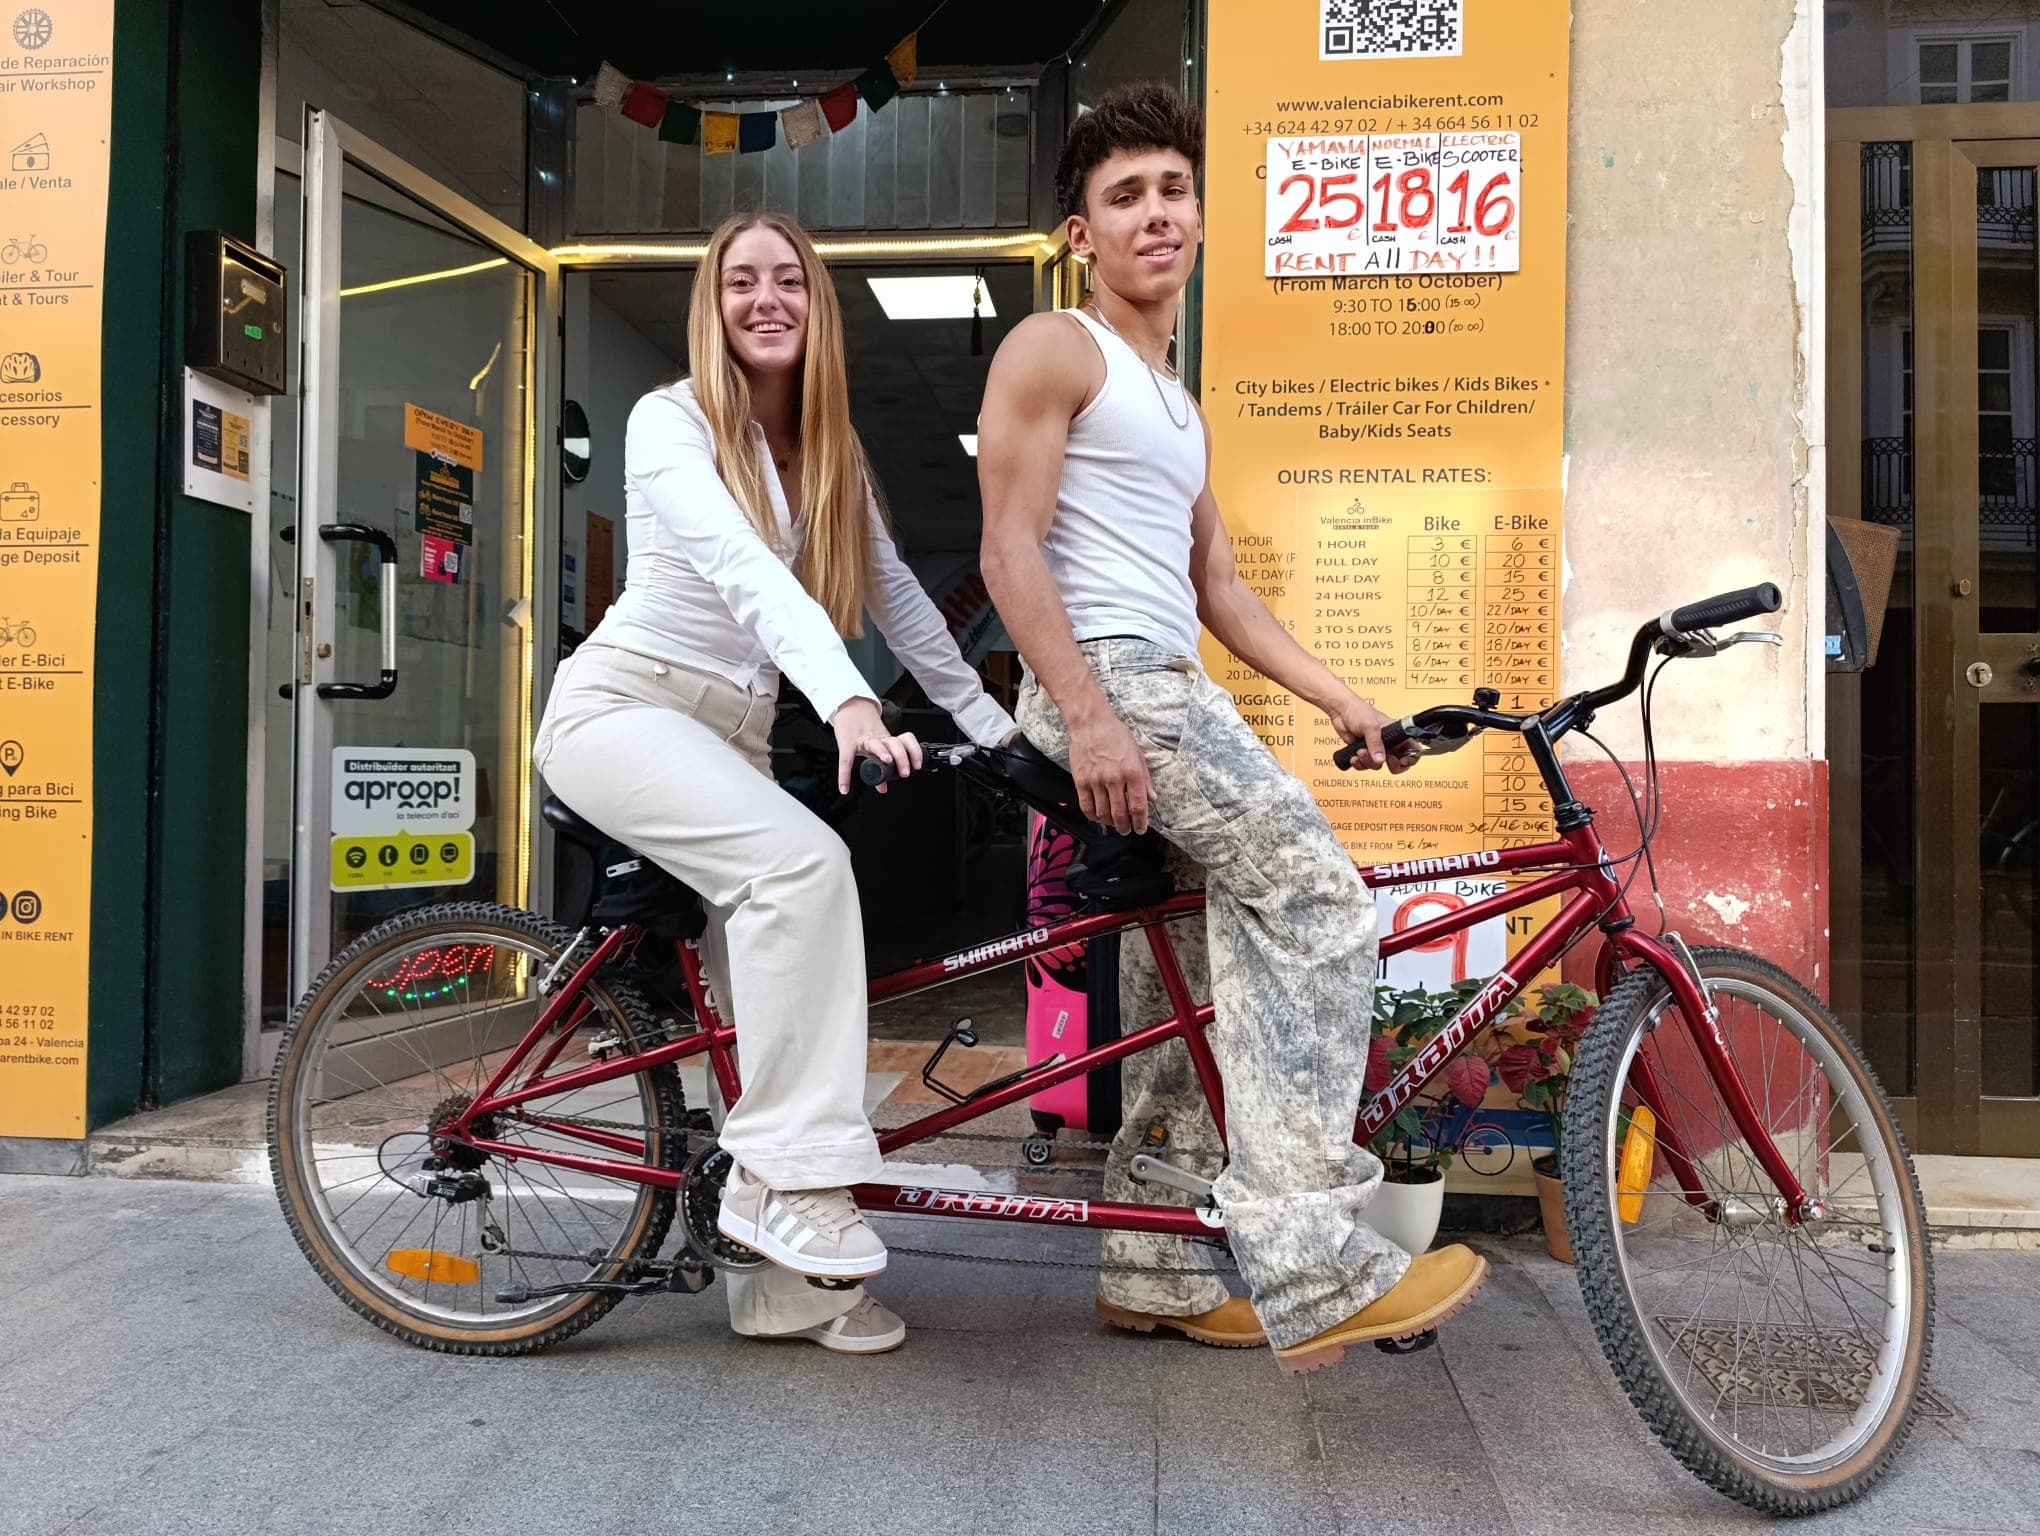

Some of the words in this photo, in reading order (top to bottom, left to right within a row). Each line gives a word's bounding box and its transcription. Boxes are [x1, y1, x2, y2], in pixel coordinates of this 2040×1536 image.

[1, 57, 19, 69] de
[24, 54, 109, 71] Reparación
[21, 78, 96, 92] Workshop
[1277, 95, 1503, 112] www.valenciabikerent.com
[1242, 121, 1272, 135] +34
[1277, 120, 1305, 134] 624
[1310, 120, 1329, 133] 42
[1334, 119, 1353, 133] 97
[1358, 119, 1377, 132] 02
[1412, 117, 1432, 130] 34
[1436, 116, 1465, 130] 664
[1471, 115, 1490, 129] 56
[1497, 115, 1512, 128] 11
[1519, 114, 1539, 128] 02
[1442, 134, 1516, 147] ELECTRIC
[1278, 139, 1365, 158] YAMAHA
[1442, 149, 1518, 168] SCOOTER
[30, 176, 72, 189] Venta
[1278, 173, 1364, 233] 25
[1373, 168, 1434, 232] 18
[1447, 169, 1515, 236] 16
[1269, 235, 1292, 246] CASH
[1372, 235, 1396, 243] CASH
[1440, 236, 1466, 245] CASH
[1276, 252, 1356, 273] RENT
[1407, 250, 1468, 272] DAY
[30, 270, 41, 283] &
[45, 269, 79, 282] Tour
[1273, 277, 1326, 292] (From
[1332, 275, 1389, 290] March
[1395, 276, 1413, 289] to
[1418, 273, 1503, 291] October)
[27, 292, 69, 305] Tours
[1333, 299, 1367, 313] 9:30
[1370, 299, 1392, 312] TO
[1330, 322, 1371, 336] 18:00
[1375, 321, 1397, 335] TO
[1235, 380, 1267, 398] City
[1272, 379, 1315, 394] bikes
[1330, 378, 1391, 393] Electric
[1395, 377, 1439, 392] bikes
[1454, 377, 1490, 392] Kids
[1495, 376, 1538, 391] Bikes
[1248, 402, 1322, 417] Tandems
[1336, 400, 1388, 416] Tráiler
[1393, 400, 1421, 415] Car
[1425, 400, 1452, 414] For
[1319, 423, 1402, 442] Baby/Kids
[1407, 424, 1452, 437] Seats
[1278, 469, 1333, 484] OURS
[1340, 468, 1416, 484] RENTAL
[1423, 468, 1491, 483] RATES:
[1320, 516, 1361, 525] Valencia
[1424, 516, 1461, 531] Bike
[1494, 515, 1549, 530] E-Bike
[16, 527, 81, 543] Equipaje
[1238, 536, 1273, 547] HOUR
[1327, 540, 1367, 549] HOUR
[1430, 536, 1445, 552] 3
[1511, 537, 1523, 551] 6
[23, 550, 81, 565] Deposit
[1259, 553, 1283, 564] DAY
[1316, 558, 1347, 567] FULL
[1352, 558, 1378, 566] DAY
[1429, 553, 1450, 568] 10
[1502, 553, 1526, 568] 20
[1315, 575, 1350, 583] HALF
[1354, 575, 1380, 583] DAY
[1432, 570, 1445, 585] 8
[1503, 570, 1525, 583] 15
[1315, 592, 1331, 600] 24
[1335, 592, 1382, 600] HOURS
[1427, 587, 1449, 601] 12
[1502, 588, 1525, 601] 25
[1326, 609, 1360, 617] DAYS
[1315, 626, 1322, 634] 3
[1326, 626, 1343, 634] TO
[1348, 626, 1354, 634] 5
[1358, 626, 1392, 634] DAYS
[1315, 641, 1322, 649] 6
[1326, 641, 1340, 649] TO
[1345, 641, 1359, 649] 10
[1362, 641, 1394, 649] DAYS
[21, 653, 65, 667] E-Bici
[1330, 659, 1344, 667] TO
[1350, 659, 1361, 667] 15
[1365, 658, 1395, 667] DAYS
[1226, 670, 1239, 680] 20
[1367, 677, 1396, 685] MONTH
[7, 677, 55, 690] E-Bike
[1511, 695, 1524, 709] 1
[410, 763, 457, 772] autoritzat
[1500, 755, 1526, 772] 20
[8, 785, 41, 798] para
[46, 782, 74, 796] Bici
[1425, 780, 1469, 789] REMOLQUE
[1501, 775, 1526, 792] 10
[344, 777, 460, 809] aproop!
[1390, 800, 1405, 808] FOR
[1415, 800, 1443, 809] HOURS
[1501, 798, 1527, 812] 15
[25, 805, 57, 819] Bike
[407, 812, 439, 820] telecom
[1354, 823, 1386, 832] DEPOSIT
[1390, 823, 1403, 832] PER
[1406, 824, 1437, 832] PERSON
[1440, 824, 1463, 832] FROM
[1350, 841, 1367, 849] BIKE
[1370, 842, 1393, 850] FROM
[1373, 850, 1500, 880] SHIMANO
[1455, 881, 1506, 896] BIKE
[2, 931, 13, 940] IN
[15, 931, 41, 941] BIKE
[44, 932, 75, 941] RENT
[943, 927, 1049, 972] SHIMANO
[6, 1005, 20, 1016] 42
[22, 1006, 37, 1017] 97
[40, 1006, 55, 1017] 02
[5, 1018, 20, 1029] 56
[23, 1019, 36, 1029] 11
[39, 1019, 55, 1030] 02
[14, 1036, 27, 1046] 24
[36, 1036, 85, 1048] Valencia
[1360, 971, 1518, 1134] ORBITA
[895, 1187, 1089, 1222] ORBITA
